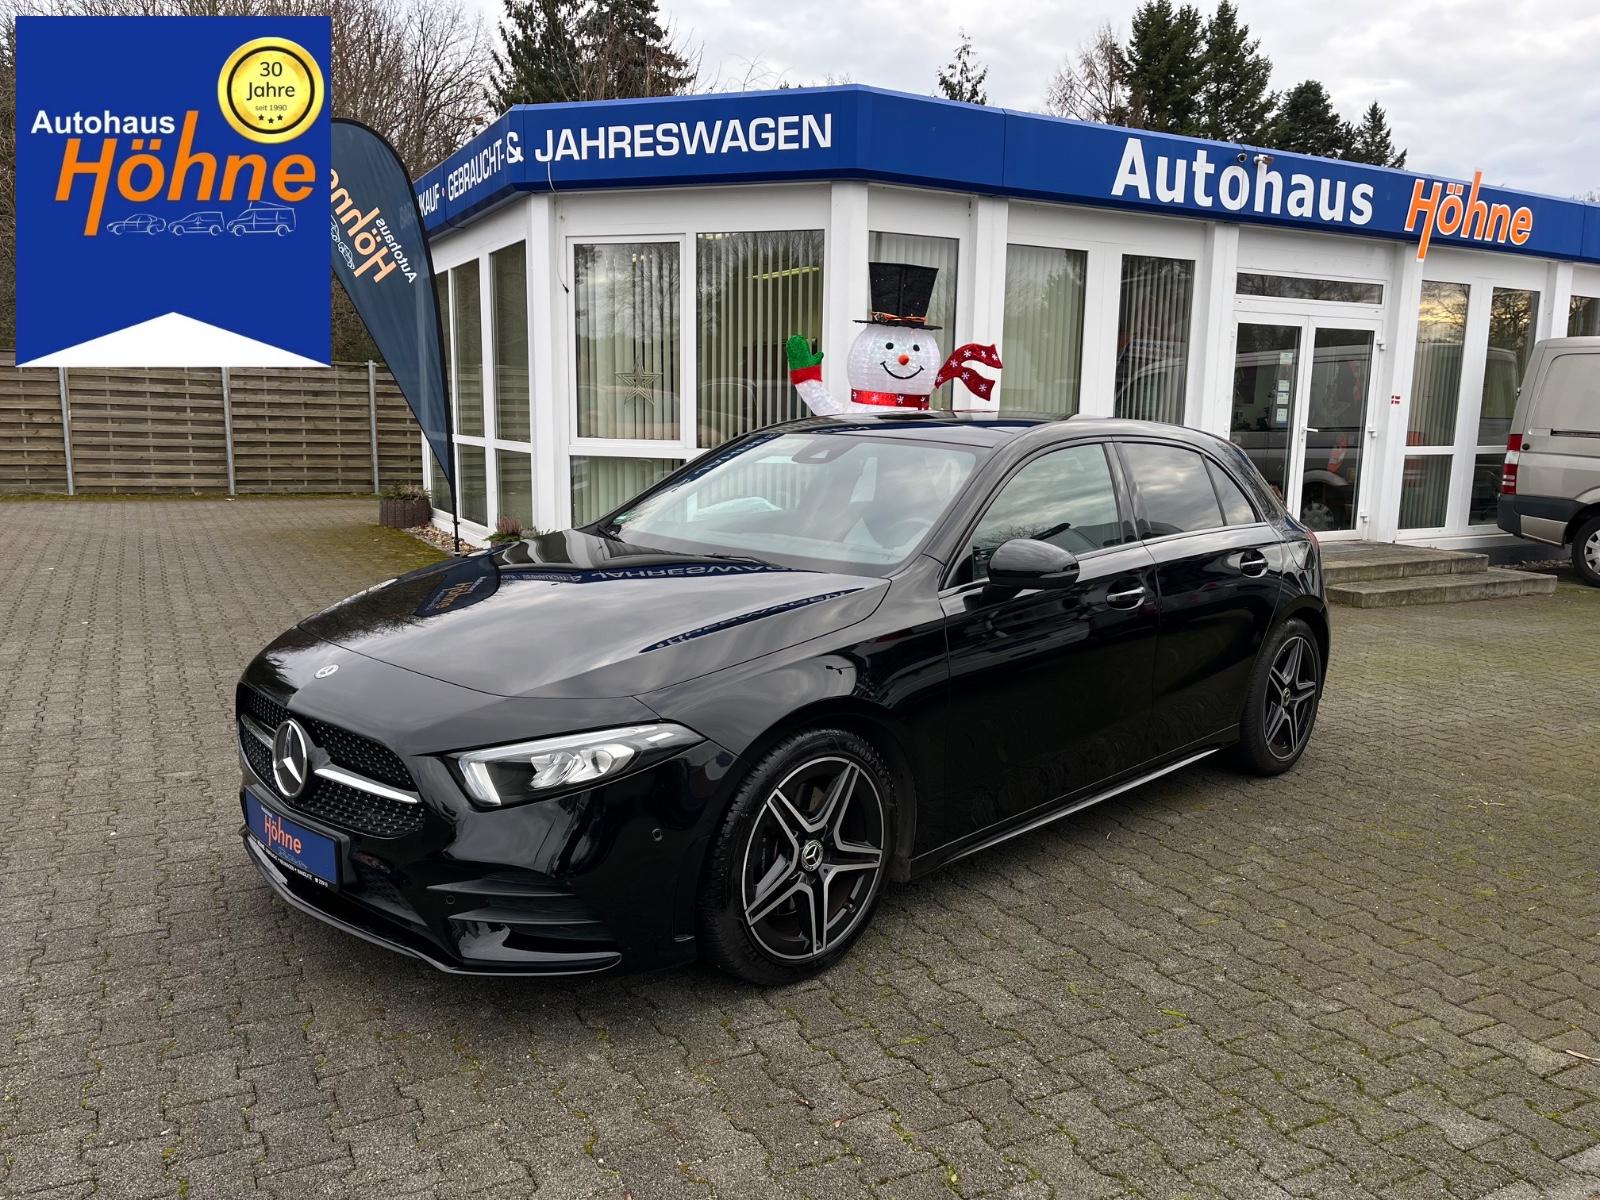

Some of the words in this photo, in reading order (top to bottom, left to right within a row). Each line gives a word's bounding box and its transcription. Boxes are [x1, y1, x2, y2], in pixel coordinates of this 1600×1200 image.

[447, 138, 505, 202] GEBRAUCHT-
[506, 131, 524, 164] &
[535, 113, 832, 163] JAHRESWAGEN
[1111, 137, 1374, 225] Autohaus
[1404, 170, 1533, 262] Höhne
[264, 814, 302, 854] Höhne
